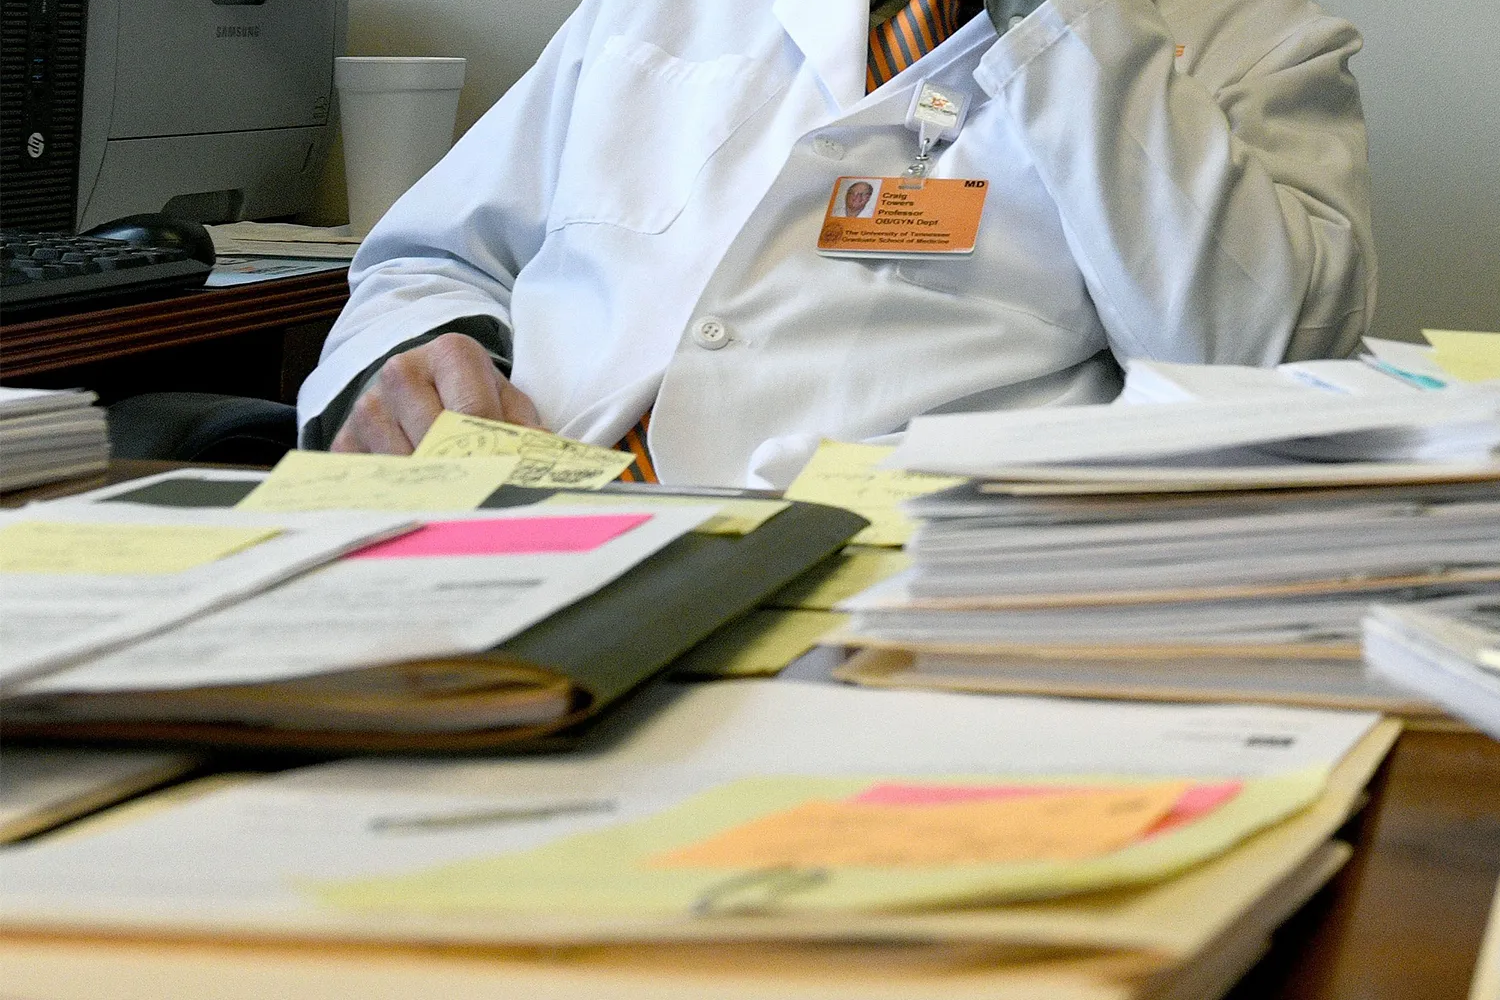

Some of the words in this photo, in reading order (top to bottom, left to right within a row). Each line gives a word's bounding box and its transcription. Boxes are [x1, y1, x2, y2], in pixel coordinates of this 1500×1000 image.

[216, 26, 260, 38] SAMSUNG
[28, 133, 44, 157] hp
[964, 180, 985, 188] MD
[882, 192, 908, 200] Craig
